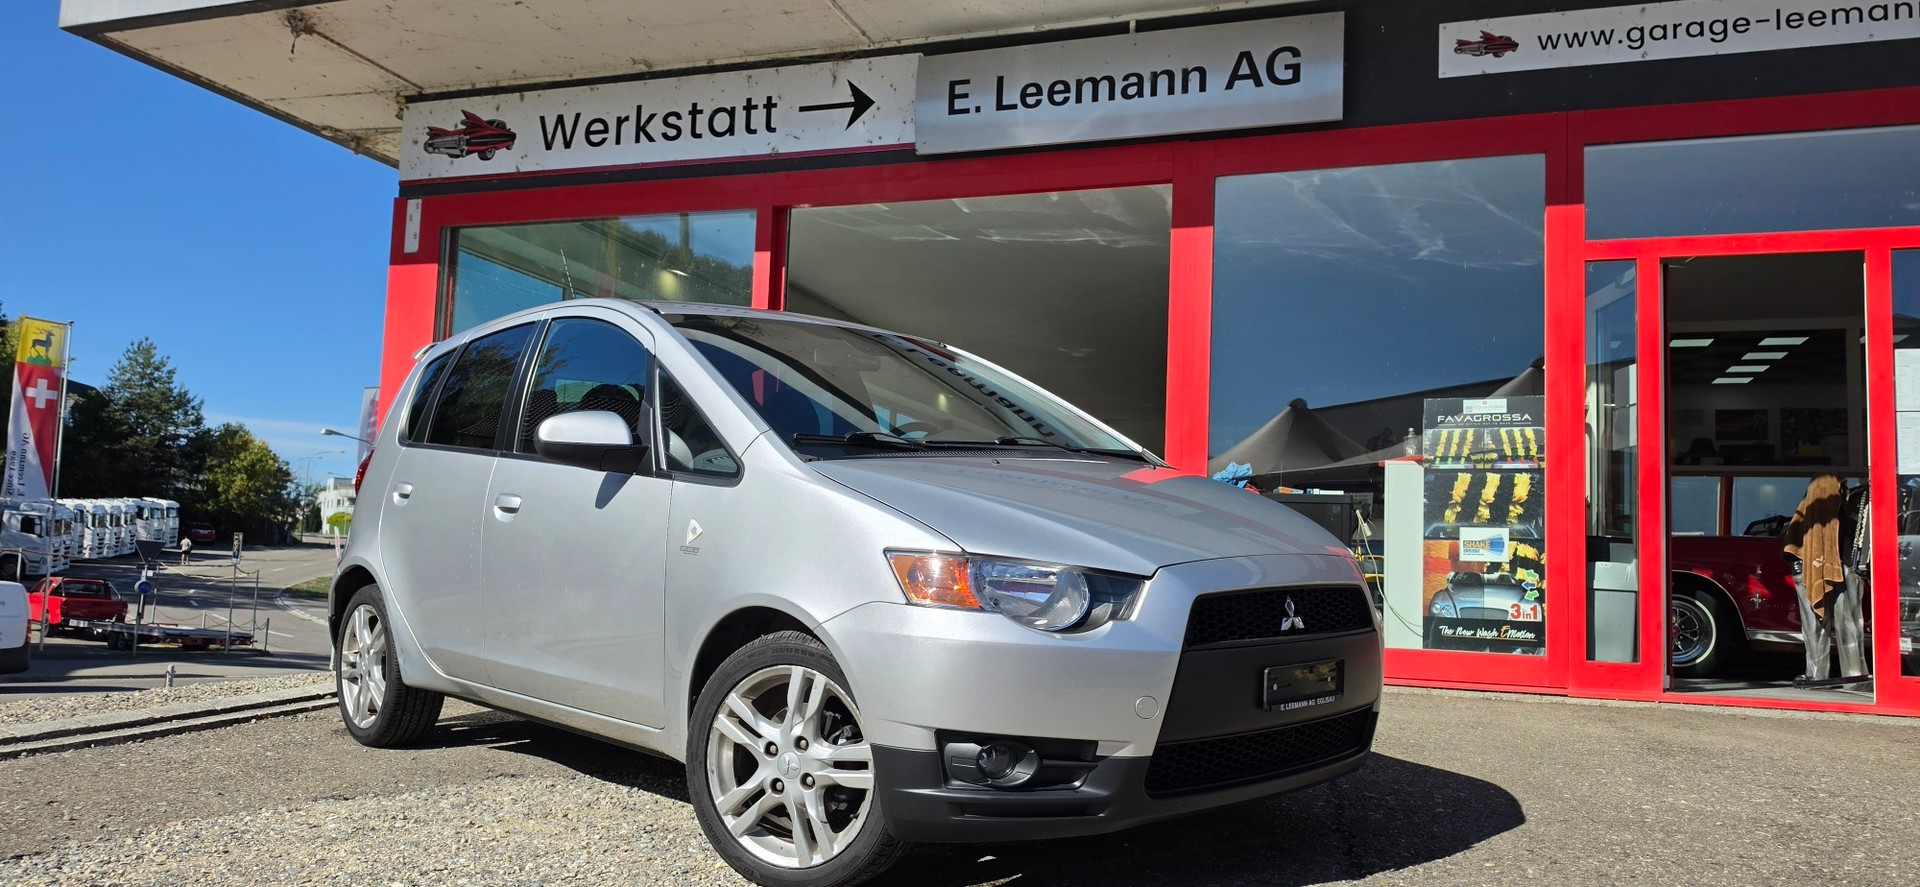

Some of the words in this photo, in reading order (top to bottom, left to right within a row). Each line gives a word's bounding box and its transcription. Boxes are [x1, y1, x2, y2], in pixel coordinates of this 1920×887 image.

[1537, 1, 1920, 51] www.garage-leeman
[947, 78, 981, 116] E.
[995, 65, 1208, 112] Leemann
[1224, 45, 1302, 91] AG
[538, 95, 778, 151] Werkstatt
[1437, 413, 1532, 423] FAVAGROSSA
[1439, 625, 1454, 636] The
[1456, 626, 1475, 636] New
[1476, 627, 1498, 639] Wash
[1286, 700, 1308, 710] LEEMANN
